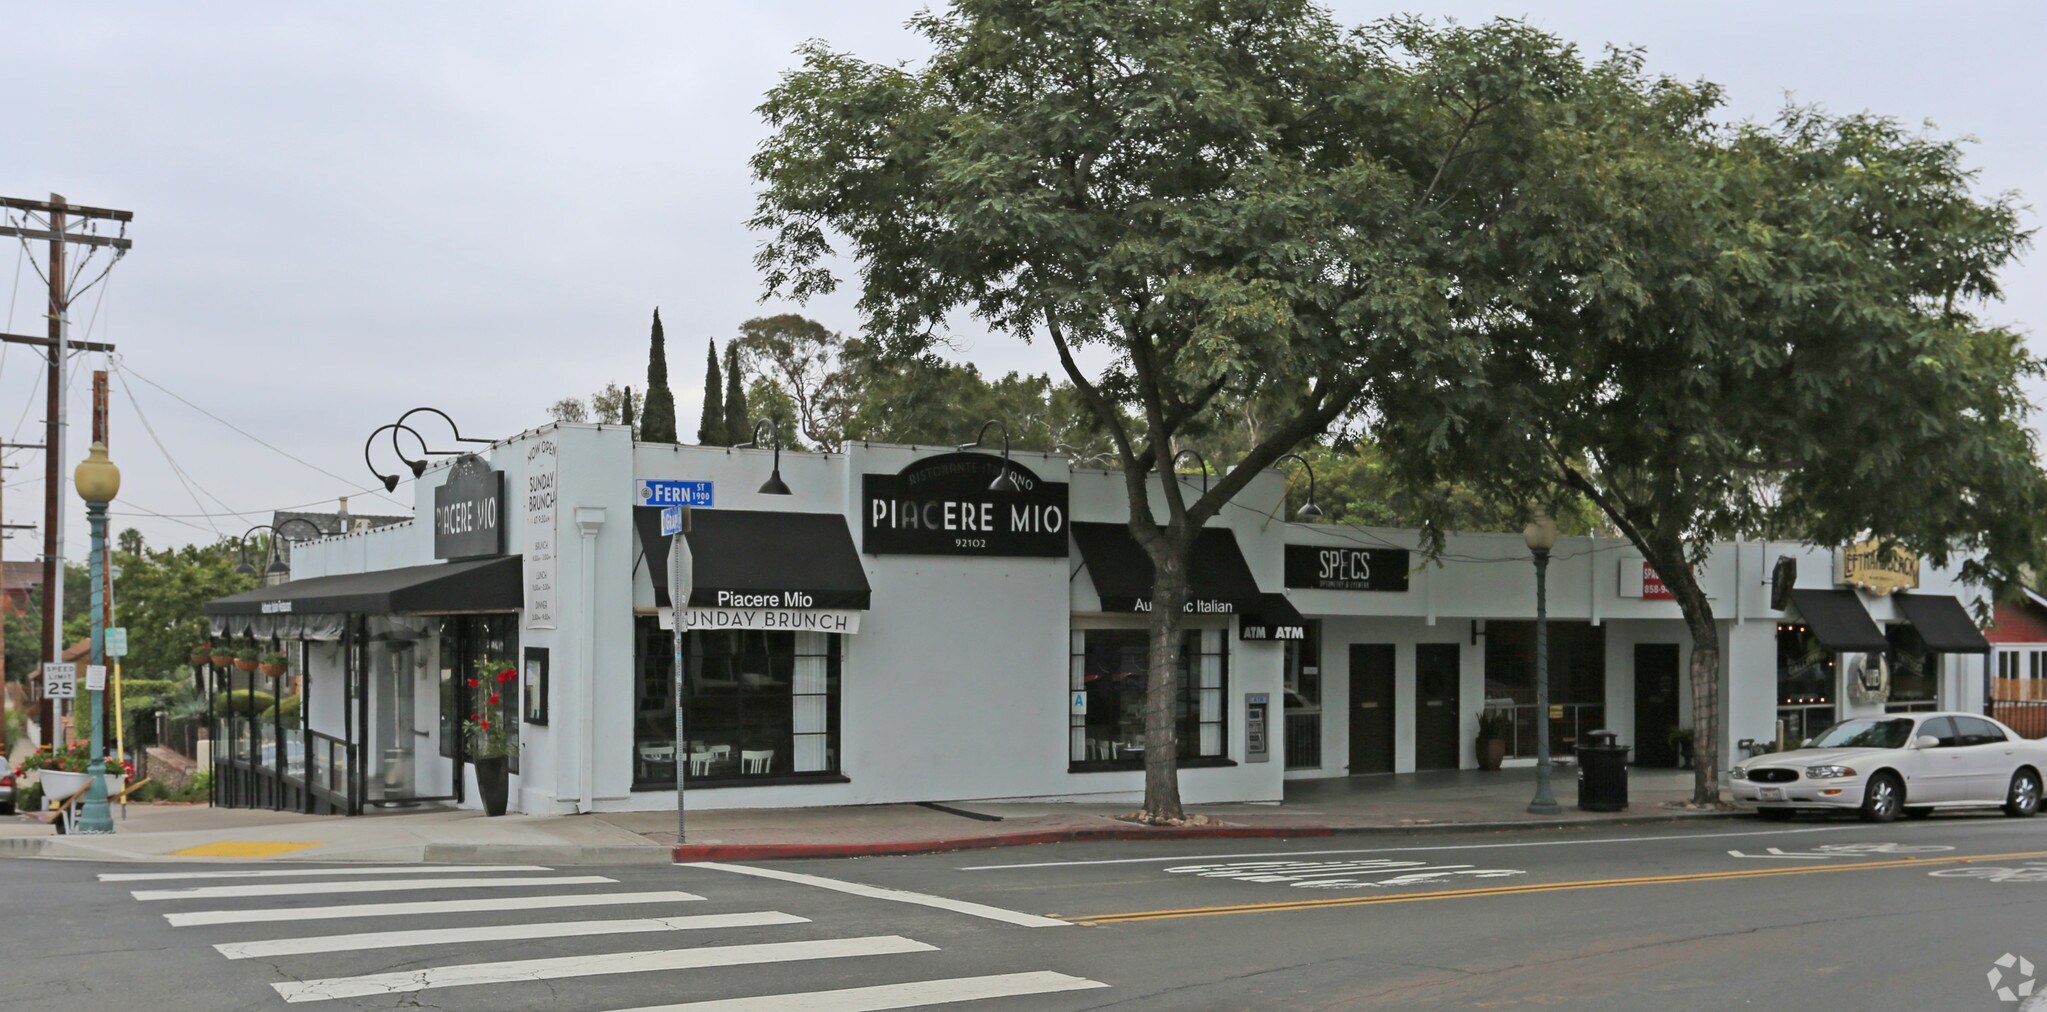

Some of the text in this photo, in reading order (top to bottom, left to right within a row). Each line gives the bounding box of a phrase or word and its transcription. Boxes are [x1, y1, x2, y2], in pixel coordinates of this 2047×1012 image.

[528, 440, 556, 464] NOW OPEN
[530, 471, 554, 492] SUNDAY
[909, 461, 978, 486] RISTORANTE
[529, 491, 556, 512] BRUNCH
[655, 483, 705, 502] FERN ST
[692, 492, 710, 501] 1900
[437, 496, 496, 535] PIACERE MIO
[872, 498, 1063, 534] PIACERE MIO
[955, 538, 987, 548] 92102
[1319, 549, 1371, 581] SPECS
[717, 591, 813, 608] Piacere Mio
[1196, 599, 1233, 613] Italian
[764, 612, 849, 630] BRUNCH
[1243, 626, 1304, 639] ATM ATM
[48, 682, 73, 695] 25
[1074, 694, 1084, 706] A
